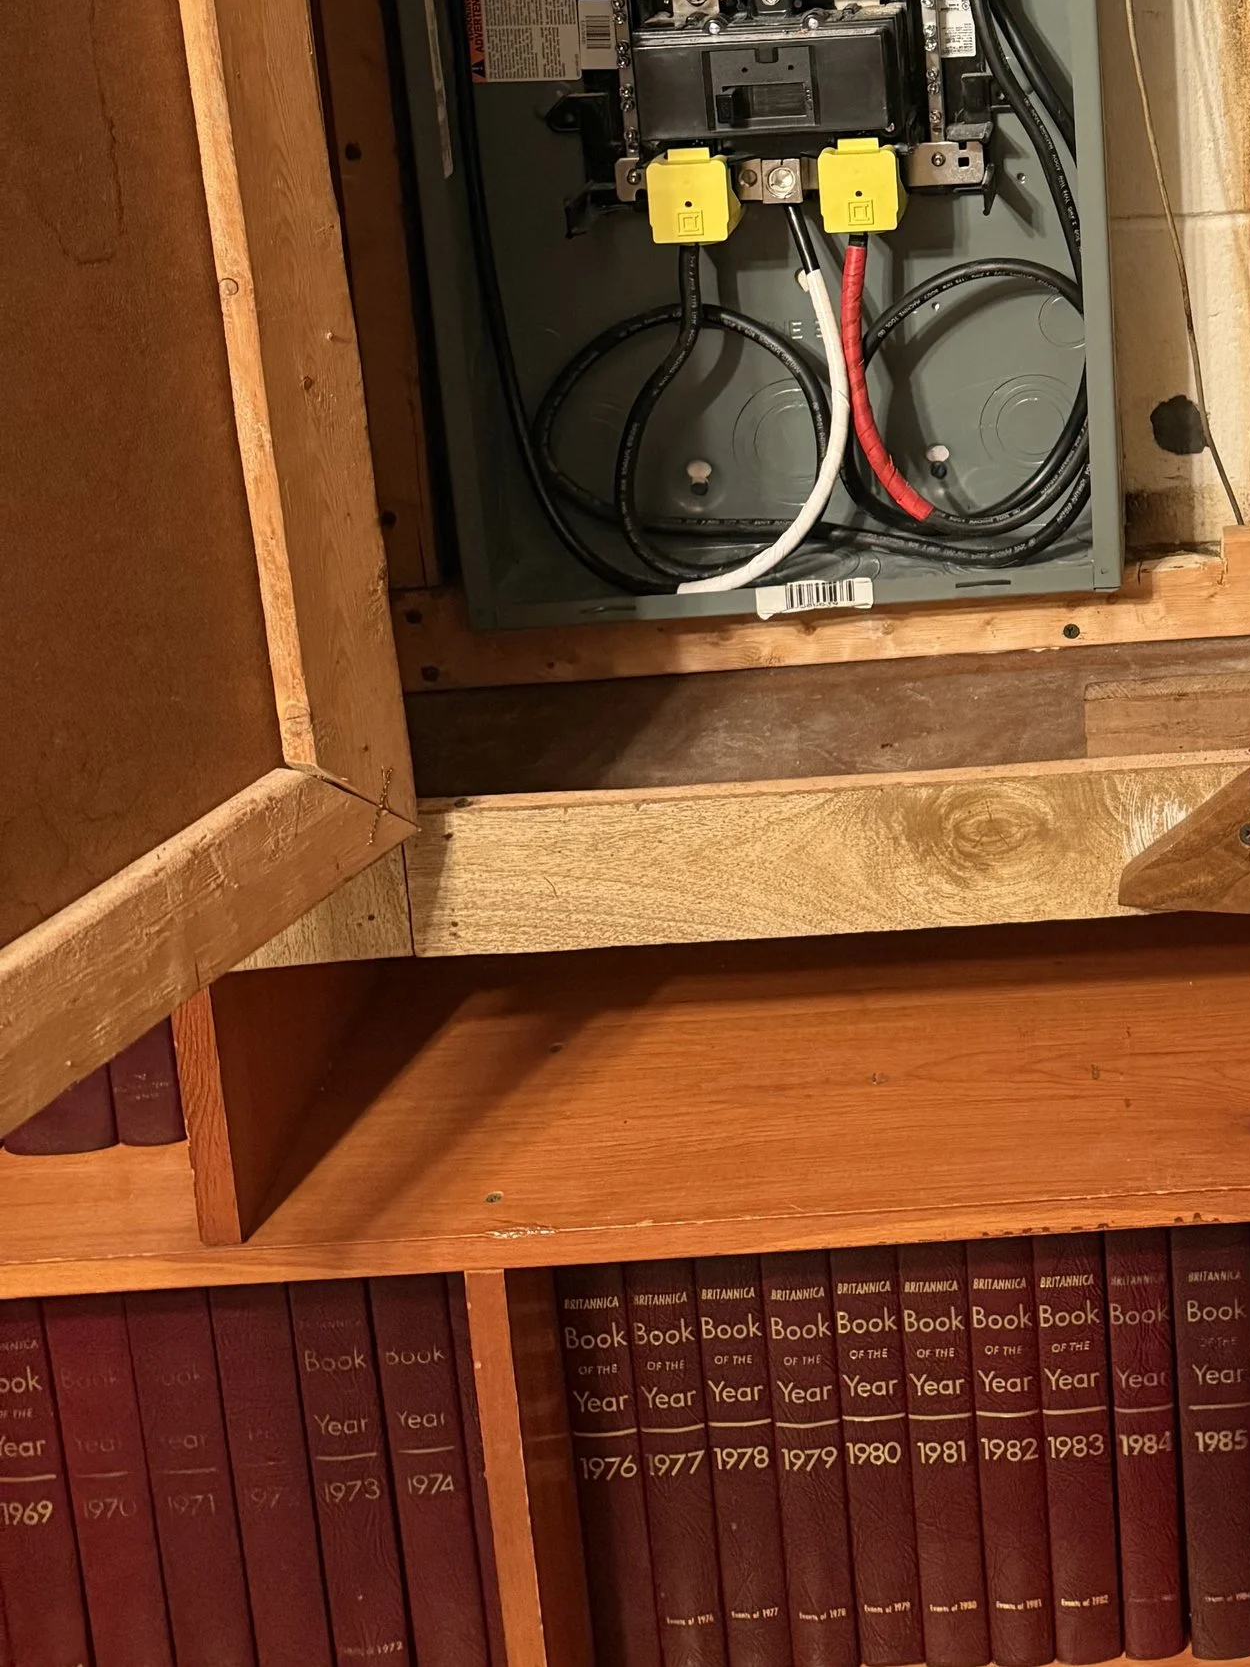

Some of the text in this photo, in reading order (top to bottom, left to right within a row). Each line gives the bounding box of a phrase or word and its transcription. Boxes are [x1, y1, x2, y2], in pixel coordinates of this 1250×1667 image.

[838, 1280, 891, 1294] BRITANNICA
[904, 1280, 958, 1293] BRITANNICA
[973, 1277, 1026, 1291] BRITANNICA
[1040, 1274, 1094, 1288] BRITANNICA
[1189, 1270, 1241, 1283] BRITANNICA
[564, 1296, 618, 1310] BRITANNICA
[634, 1292, 688, 1306] BRITANNICA
[702, 1287, 755, 1300] BRITANNICA
[771, 1286, 825, 1300] BRITANNICA
[838, 1307, 898, 1335] Book
[904, 1307, 964, 1332] Book
[973, 1304, 1032, 1331] Book
[1040, 1302, 1100, 1327] Book
[1111, 1303, 1169, 1326] Book
[1187, 1299, 1247, 1322] Book
[565, 1323, 627, 1350] Book
[634, 1319, 695, 1346] Book
[702, 1315, 762, 1341] Book
[771, 1313, 831, 1341] Book
[304, 1344, 367, 1372] Book
[647, 1359, 684, 1372] OF THE
[714, 1354, 752, 1365] OF THE
[850, 1348, 888, 1360] OF THE
[843, 1375, 898, 1397] Year
[910, 1374, 964, 1396] Year
[978, 1372, 1033, 1394] Year
[1045, 1369, 1100, 1391] Year
[1117, 1369, 1168, 1389] Year
[1193, 1364, 1247, 1385] Year
[573, 1391, 629, 1414] Year
[641, 1387, 696, 1409] Year
[708, 1381, 763, 1404] Year
[777, 1382, 832, 1404] Year
[314, 1414, 370, 1436] Year
[846, 1441, 901, 1464] 1980
[917, 1440, 967, 1464] 1981
[981, 1438, 1039, 1461] 1982
[1048, 1435, 1104, 1459] 1983
[1120, 1432, 1172, 1455] 1984
[1195, 1430, 1248, 1452] 1985
[580, 1455, 637, 1481] 1976
[648, 1450, 705, 1476] 1977
[714, 1446, 770, 1470] 1978
[782, 1446, 838, 1471] 1979
[324, 1478, 380, 1502] 1973
[408, 1473, 454, 1495] 1974
[0, 1500, 53, 1525] 1969
